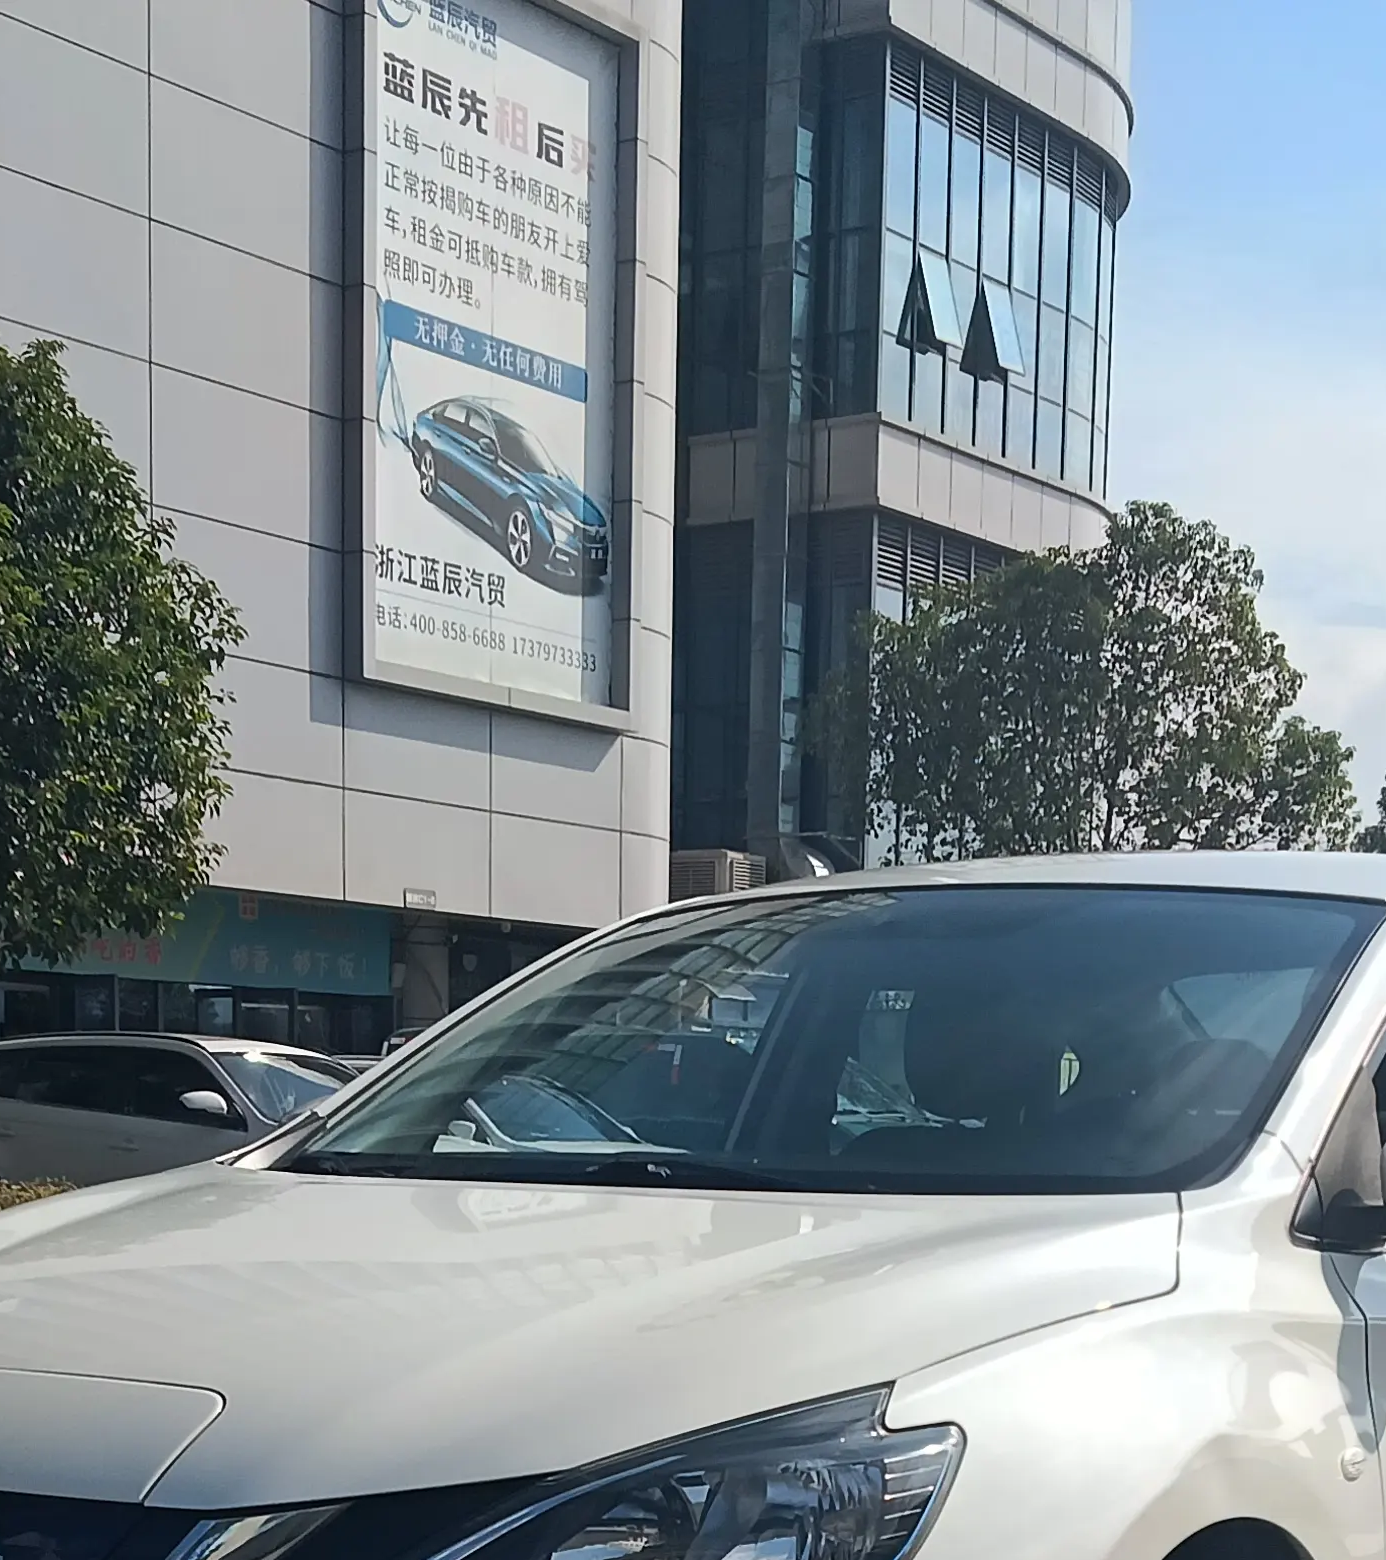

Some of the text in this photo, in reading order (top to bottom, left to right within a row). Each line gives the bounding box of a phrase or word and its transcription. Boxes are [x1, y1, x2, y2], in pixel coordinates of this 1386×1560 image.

[383, 51, 596, 182] 蓝辰先租后买
[384, 120, 592, 227] 让每一位由于各种原因不能
[384, 161, 590, 267] 正常按揭购车的朋友开上爱
[383, 250, 481, 310] 照即可办理。
[375, 544, 506, 608] 浙江蓝辰汽贸
